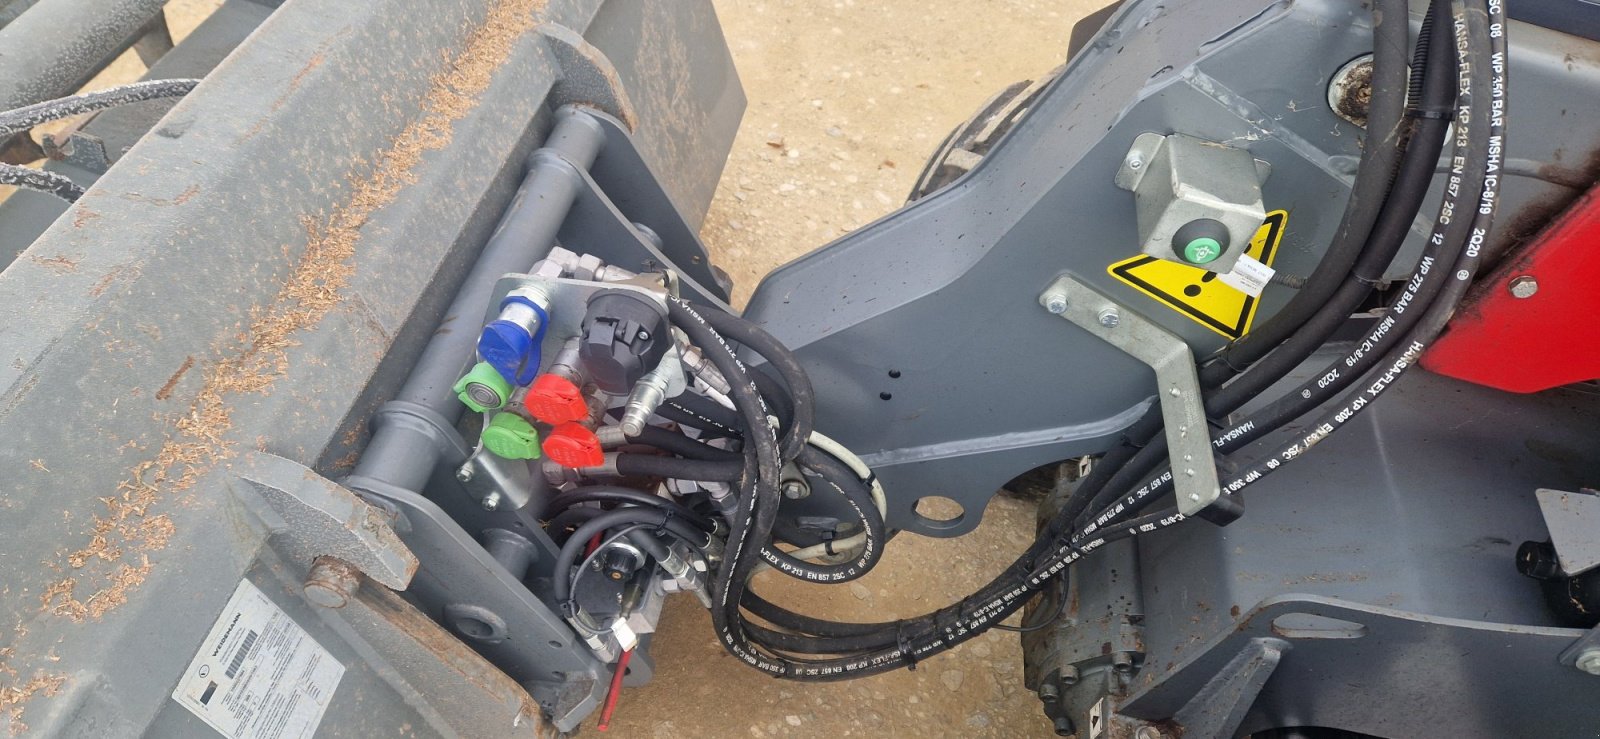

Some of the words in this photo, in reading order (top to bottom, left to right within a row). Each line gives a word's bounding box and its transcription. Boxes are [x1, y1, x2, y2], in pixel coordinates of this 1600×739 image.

[1490, 24, 1502, 38] 08
[1454, 14, 1470, 96] HANSA-FLEX
[1492, 52, 1503, 77] WP
[1492, 78, 1503, 98] 350
[1460, 106, 1470, 124] KP
[1491, 100, 1503, 127] BAR
[1457, 127, 1469, 146] 213
[1486, 136, 1502, 172] MSHA
[1453, 156, 1465, 174] EN
[1447, 176, 1460, 197] 857
[1479, 174, 1497, 215] IC-8/19
[1440, 201, 1454, 225] 2SC
[1432, 233, 1444, 245] 12
[1466, 228, 1486, 257] 2Q20
[1420, 256, 1434, 275] WP
[1408, 273, 1424, 293] 275
[1394, 292, 1413, 314] BAR
[681, 303, 705, 324] MSHA
[708, 326, 726, 345] BAR
[735, 359, 747, 374] WP
[1370, 316, 1395, 342] MSHA
[1346, 340, 1373, 367] IC-8/19
[1318, 368, 1340, 388] 2Q20
[1366, 340, 1424, 396] HANSA-FLEX
[1353, 396, 1368, 411] KP
[1335, 408, 1353, 423] 208
[1320, 422, 1334, 435] EN
[1267, 459, 1280, 469] 08
[1151, 478, 1162, 491] 857
[1160, 471, 1172, 482] EN
[1229, 479, 1246, 492] 350
[1246, 470, 1262, 482] WP
[781, 562, 792, 571] KP
[791, 566, 803, 576] 213
[807, 569, 817, 580] EN
[818, 571, 829, 581] 857
[832, 571, 846, 581] 2SC
[212, 612, 242, 657] WEIDEMANN
